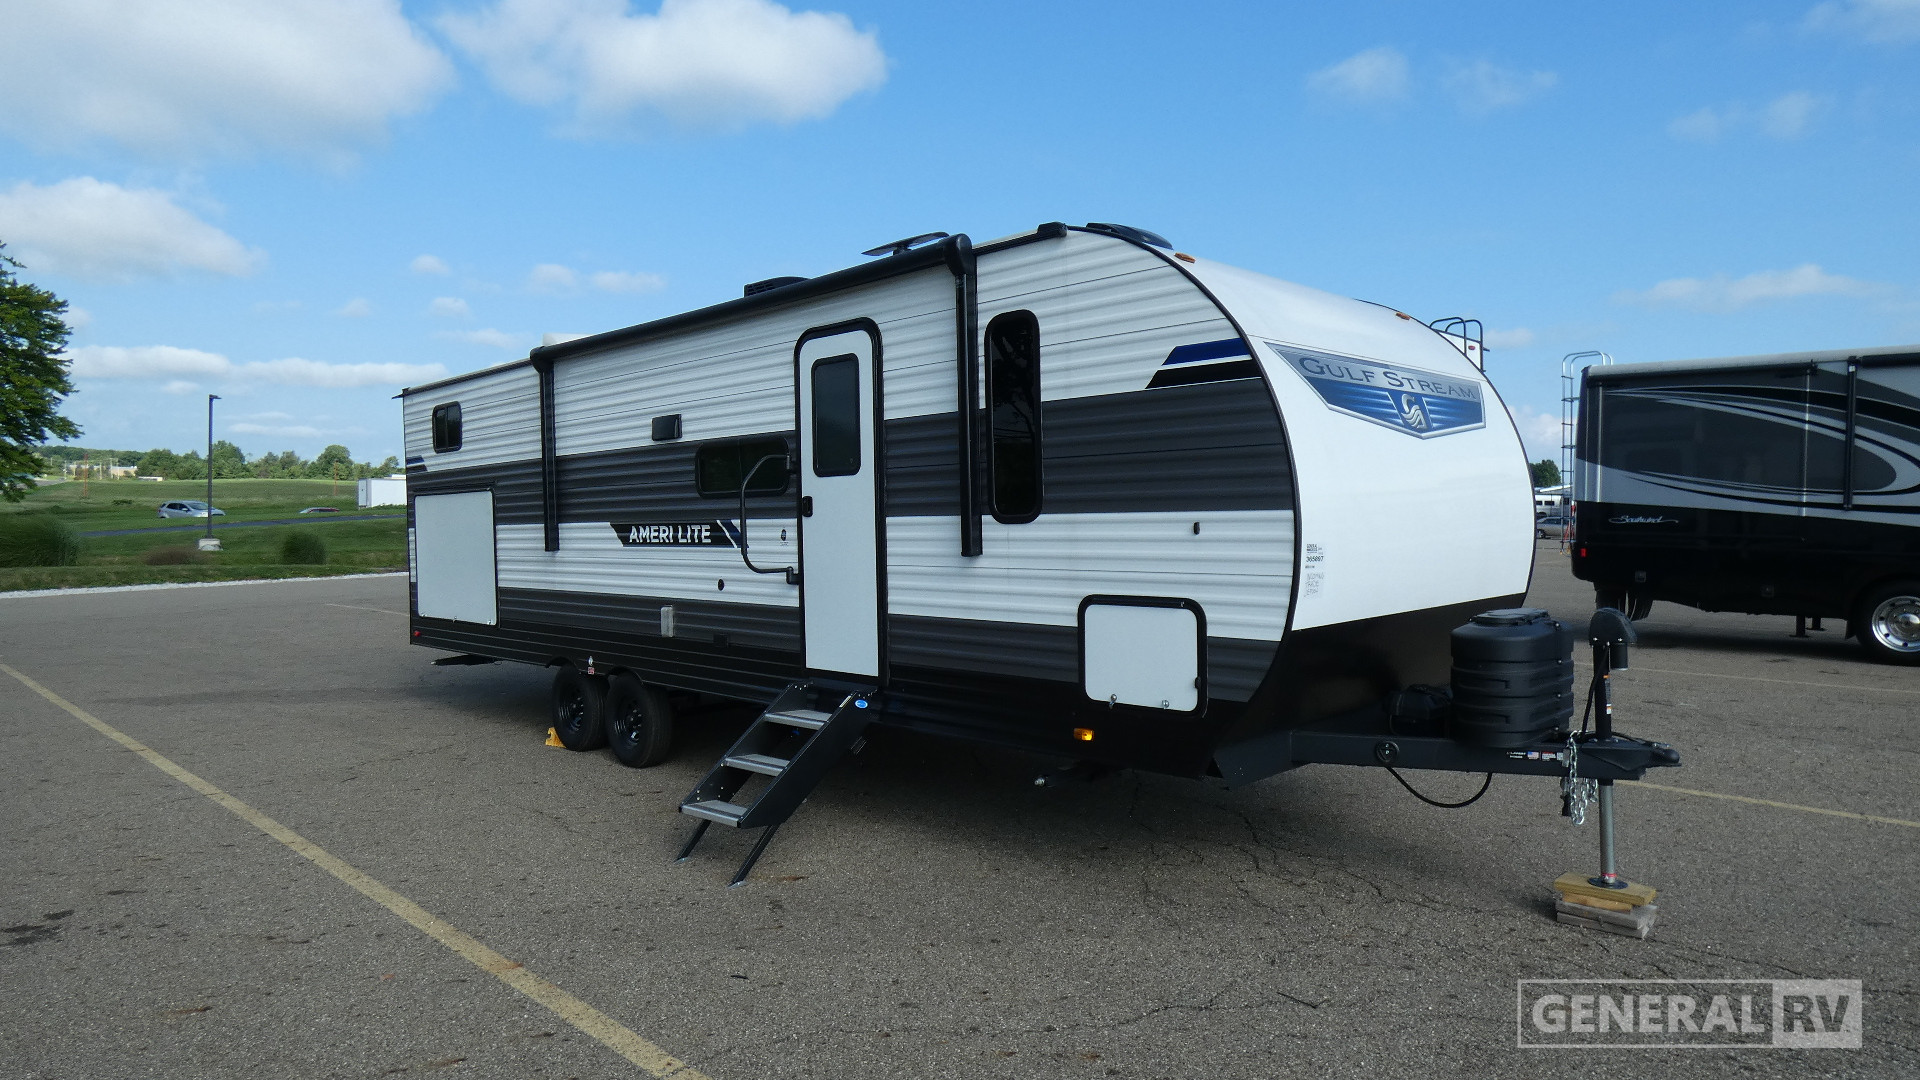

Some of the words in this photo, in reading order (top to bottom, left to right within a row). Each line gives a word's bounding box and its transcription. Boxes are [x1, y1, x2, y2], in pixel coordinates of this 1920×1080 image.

[1298, 357, 1375, 383] GULF
[1382, 371, 1475, 399] STREAM
[629, 525, 674, 543] AMERI
[678, 524, 712, 543] LITE
